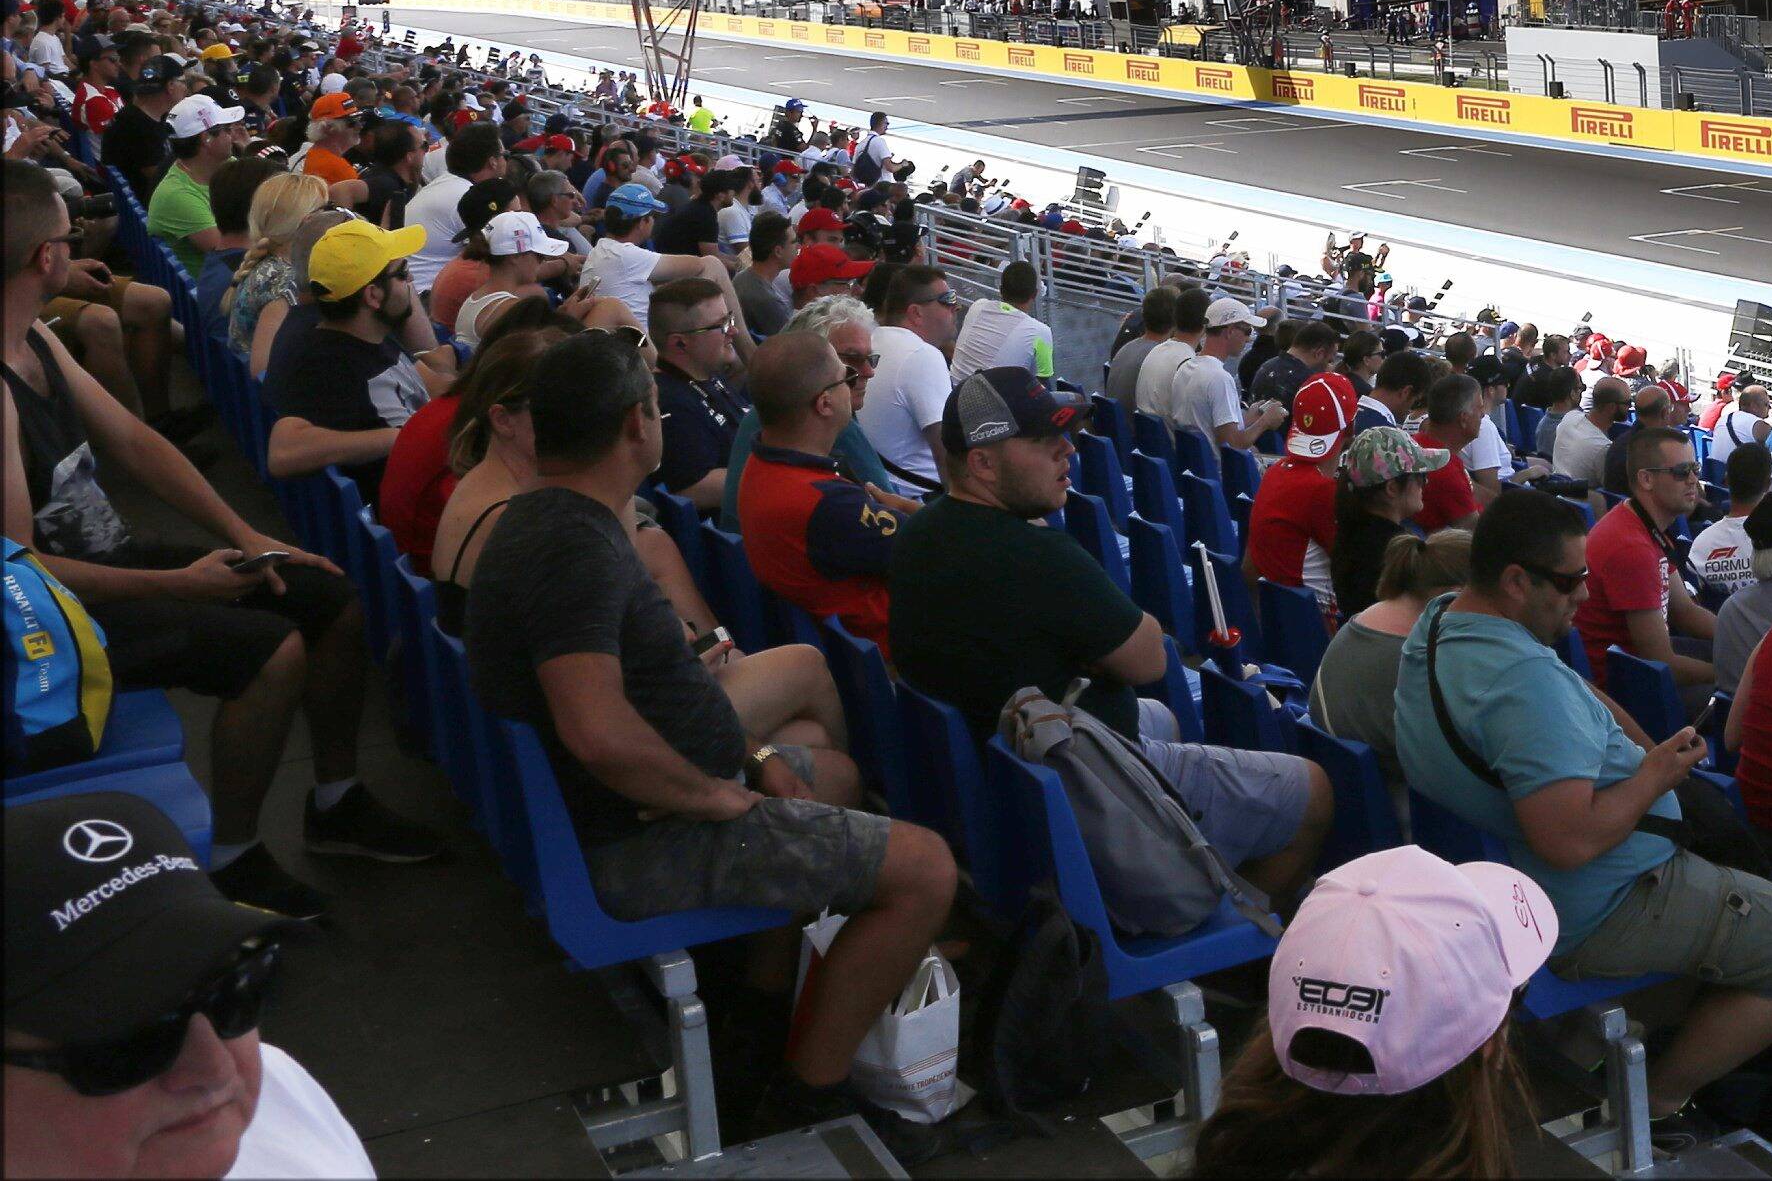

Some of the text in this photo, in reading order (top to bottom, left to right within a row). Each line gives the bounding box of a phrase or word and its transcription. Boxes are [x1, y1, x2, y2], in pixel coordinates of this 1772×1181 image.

[908, 36, 930, 55] PIRELLI
[956, 42, 980, 61] PIRELLI
[1008, 47, 1034, 68] PIRELLI
[1064, 52, 1094, 74] PIRELLI
[1126, 59, 1160, 83] PIRELLI
[1196, 66, 1233, 92] PIRELLI
[1272, 74, 1314, 102] PIRELLI
[1358, 84, 1406, 112] PIRELLI
[1456, 94, 1510, 125] PIRELLI
[1571, 106, 1633, 140] PIRELLI
[1700, 120, 1772, 156] PIRELLI
[970, 424, 1010, 442] carsales
[860, 502, 898, 538] 3
[1706, 545, 1739, 561] F1
[1705, 558, 1751, 573] FORMU
[1296, 1001, 1380, 1024] ESTEBAN OCON
